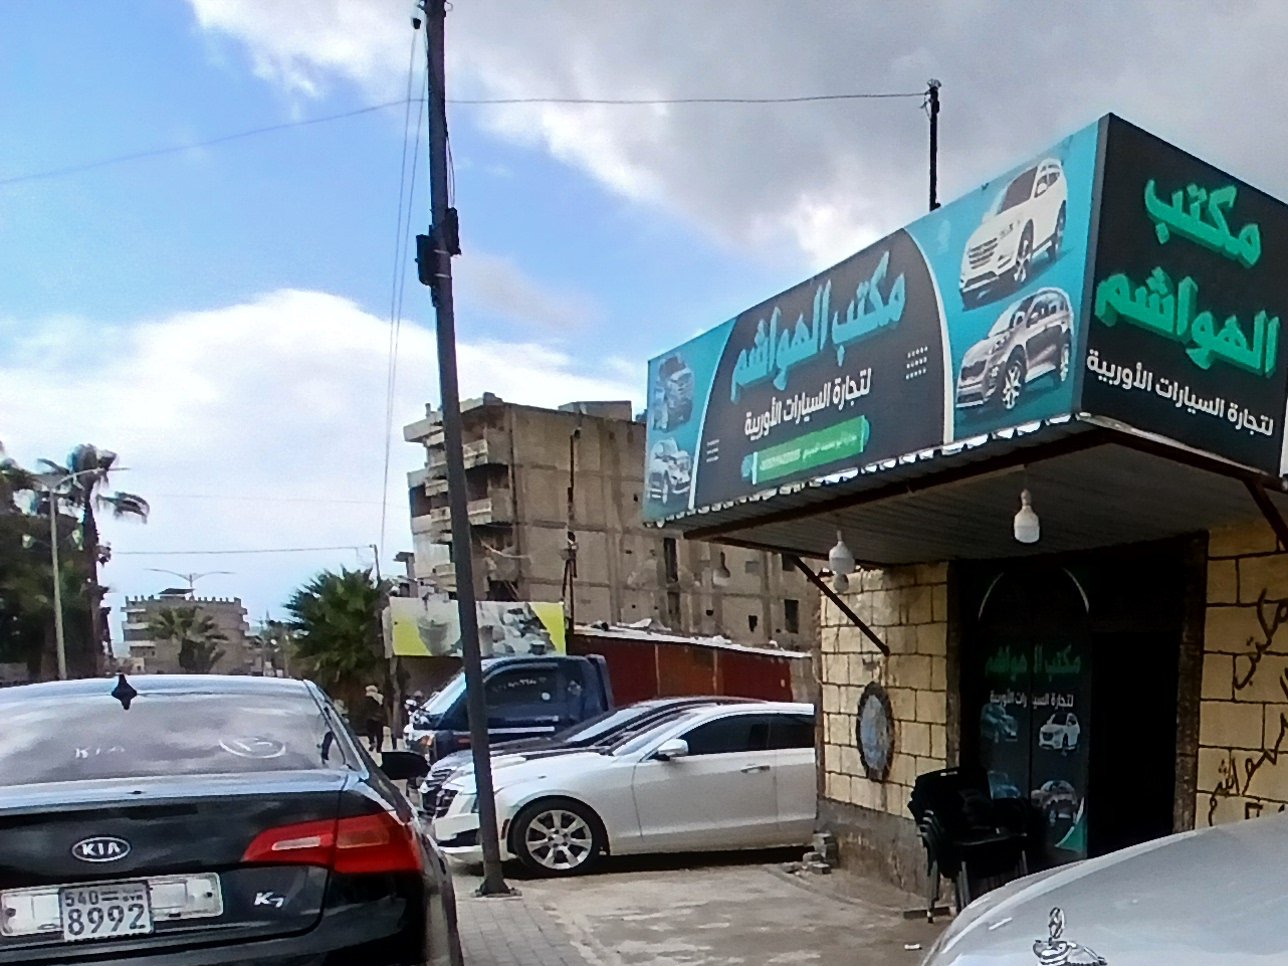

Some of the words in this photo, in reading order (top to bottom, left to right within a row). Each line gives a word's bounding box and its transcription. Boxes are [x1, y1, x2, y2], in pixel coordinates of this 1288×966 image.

[1144, 179, 1263, 267] مكتب
[832, 250, 907, 367] مكتب
[1095, 267, 1279, 377] الهواشم
[730, 279, 832, 404] الهواشم
[833, 367, 872, 411] لتجارة
[1086, 348, 1153, 393] الأوربية
[744, 396, 783, 440] الأوربية
[782, 382, 831, 425] السيارات
[1155, 376, 1225, 418] السيارات
[1227, 402, 1274, 436] لتجارة
[64, 889, 99, 907] 540
[67, 903, 147, 936] 8992
[253, 891, 285, 908] K7
